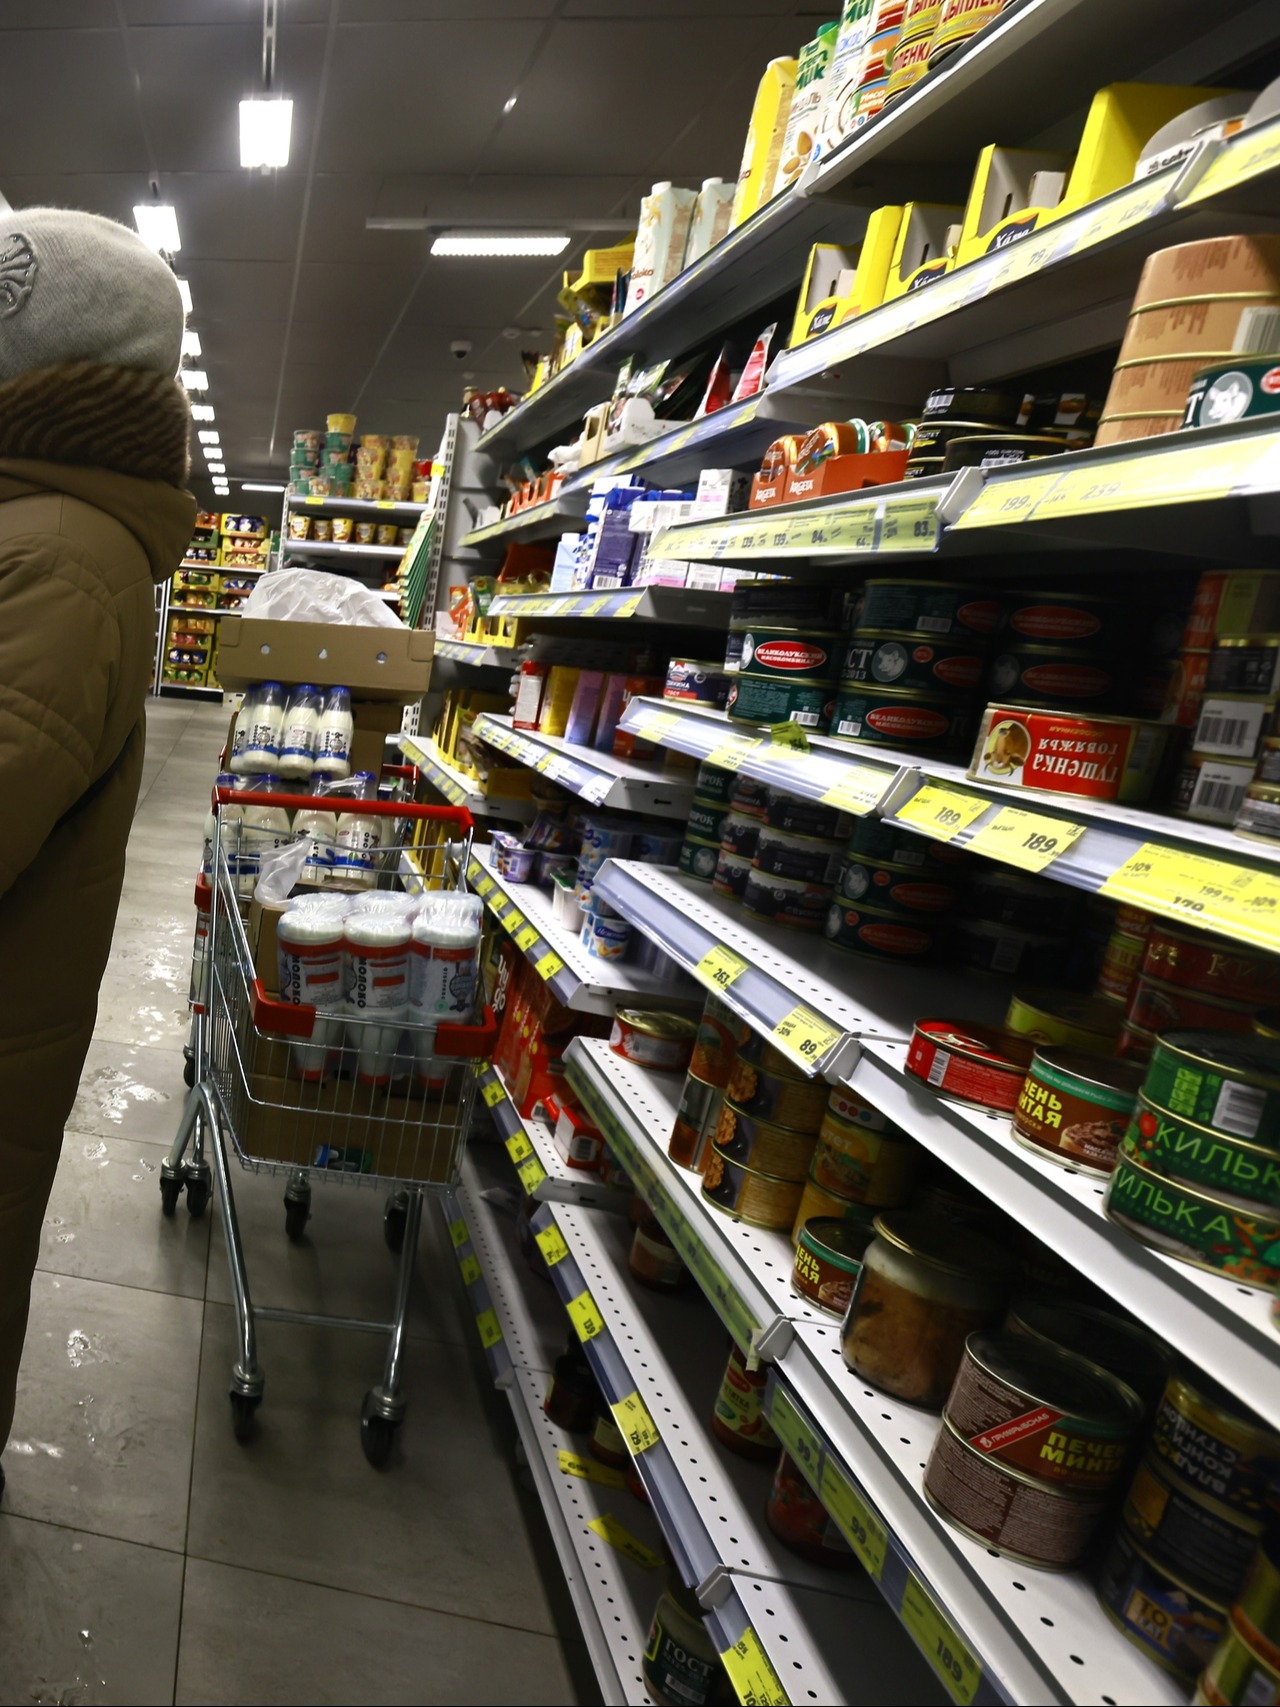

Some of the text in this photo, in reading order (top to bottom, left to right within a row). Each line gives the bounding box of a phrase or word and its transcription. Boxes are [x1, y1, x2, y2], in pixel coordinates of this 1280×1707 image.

[789, 478, 815, 495] ARGETA
[999, 494, 1027, 511] 199
[914, 520, 929, 537] 83
[844, 648, 873, 669] СТ
[933, 806, 962, 827] 189
[1021, 832, 1059, 854] 189
[713, 967, 731, 985] 263
[799, 1039, 817, 1056] 89
[1116, 1166, 1231, 1241] ИЛЬКА
[583, 1318, 596, 1336] 139
[628, 1429, 642, 1447] 129
[992, 1412, 1051, 1444] ПРИМРЫБСНАБ
[850, 1515, 867, 1546] 99
[665, 1638, 715, 1678] ГОСТ
[935, 1636, 963, 1684] 189
